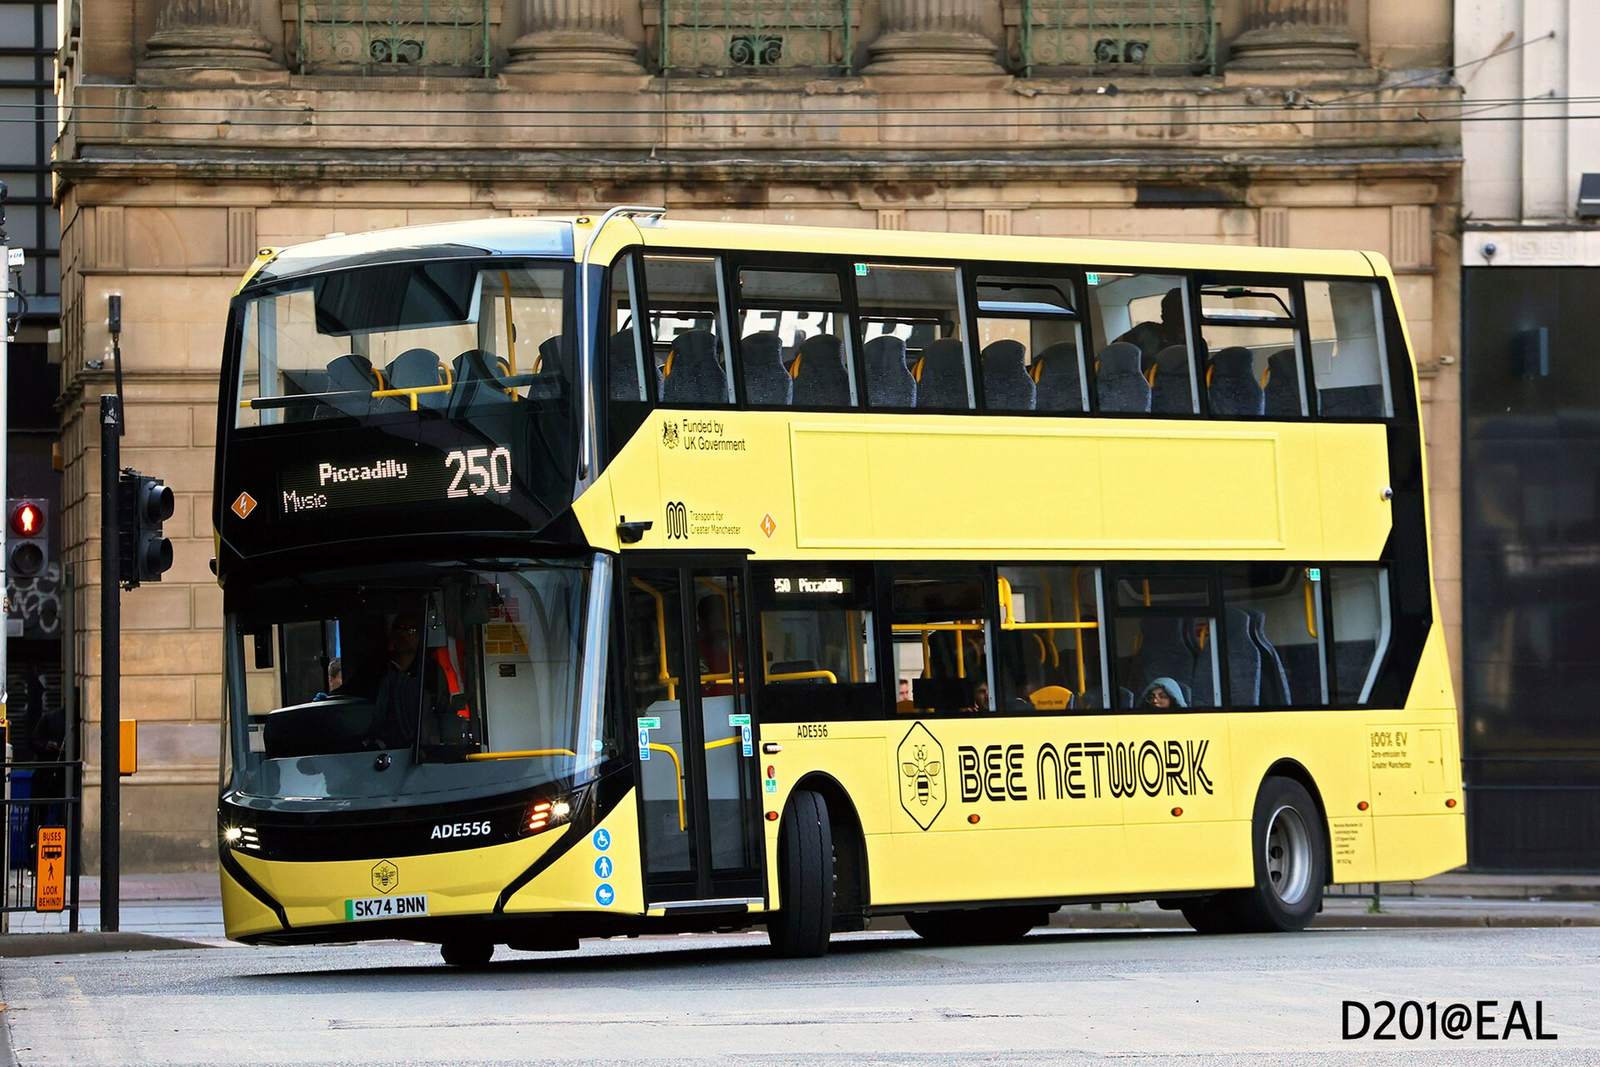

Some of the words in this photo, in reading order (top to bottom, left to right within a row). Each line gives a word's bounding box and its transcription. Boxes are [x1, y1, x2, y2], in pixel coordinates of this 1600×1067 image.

[683, 419, 713, 433] Funded
[714, 420, 724, 436] by
[683, 436, 696, 450] UK
[698, 436, 746, 451] Government
[318, 459, 408, 486] Piccadilly
[444, 447, 512, 498] 250
[282, 490, 328, 513] Music
[690, 510, 715, 521] Transport
[716, 510, 724, 521] for
[690, 524, 710, 534] Greater
[711, 524, 741, 534] Manchester
[797, 724, 828, 738] ADE556
[1370, 731, 1393, 747] 100%
[1395, 731, 1408, 747] EV
[958, 744, 1028, 803] BEE
[1036, 740, 1213, 801] NETWORK
[43, 832, 62, 841] BUSES
[430, 821, 491, 840] ADE556
[43, 886, 58, 895] LOOK
[39, 897, 62, 907] BEHIND!
[355, 899, 392, 917] SK74
[396, 896, 426, 914] BNN
